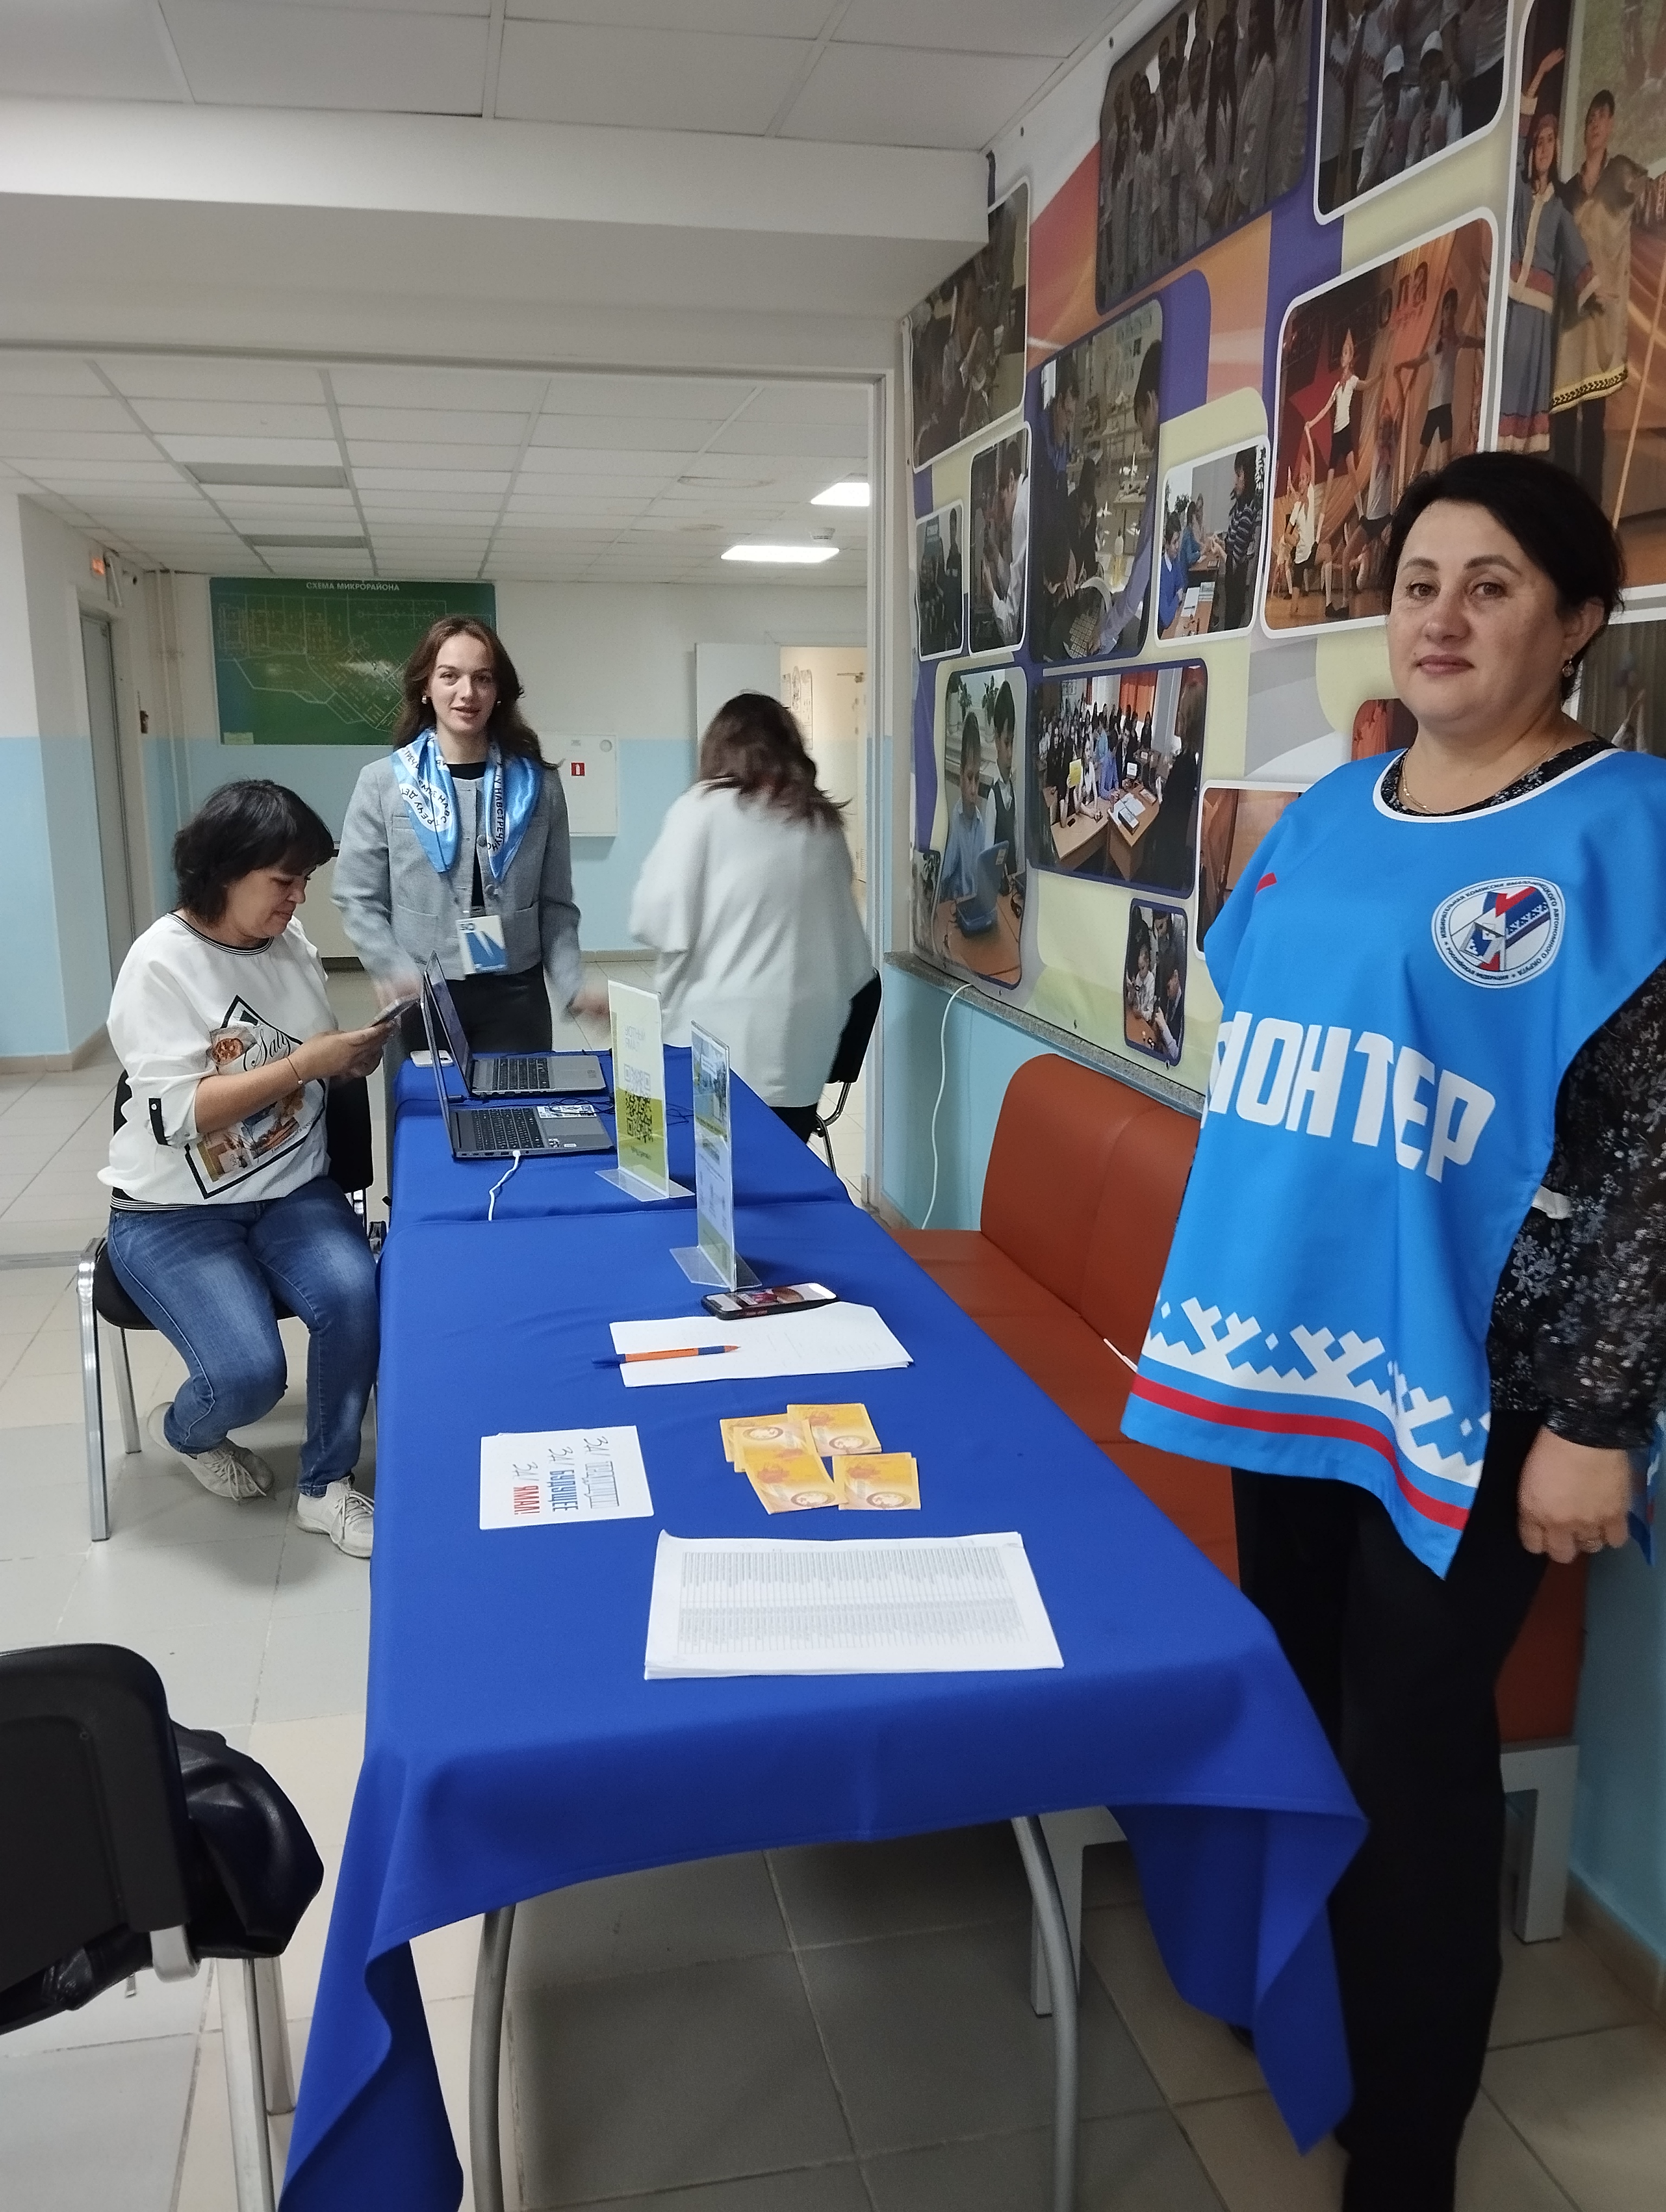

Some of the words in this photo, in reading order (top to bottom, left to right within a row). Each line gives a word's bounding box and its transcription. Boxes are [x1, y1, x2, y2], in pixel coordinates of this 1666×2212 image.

[306, 581, 335, 589] СХЕМА
[336, 582, 400, 591] МИКРОРАЙОНА
[494, 787, 504, 846] НАВСТРЕЧУ
[1466, 883, 1504, 897] КОМИССИЯ
[1440, 895, 1465, 938] ИЗБИРАТЕЛЬНАЯ
[1544, 908, 1560, 959] АВТОНОМНОГО
[1517, 958, 1542, 976] ОКРУГА
[513, 1485, 540, 1515] ЯМАЛ!
[546, 1469, 579, 1512] БУДУЩЕЕ
